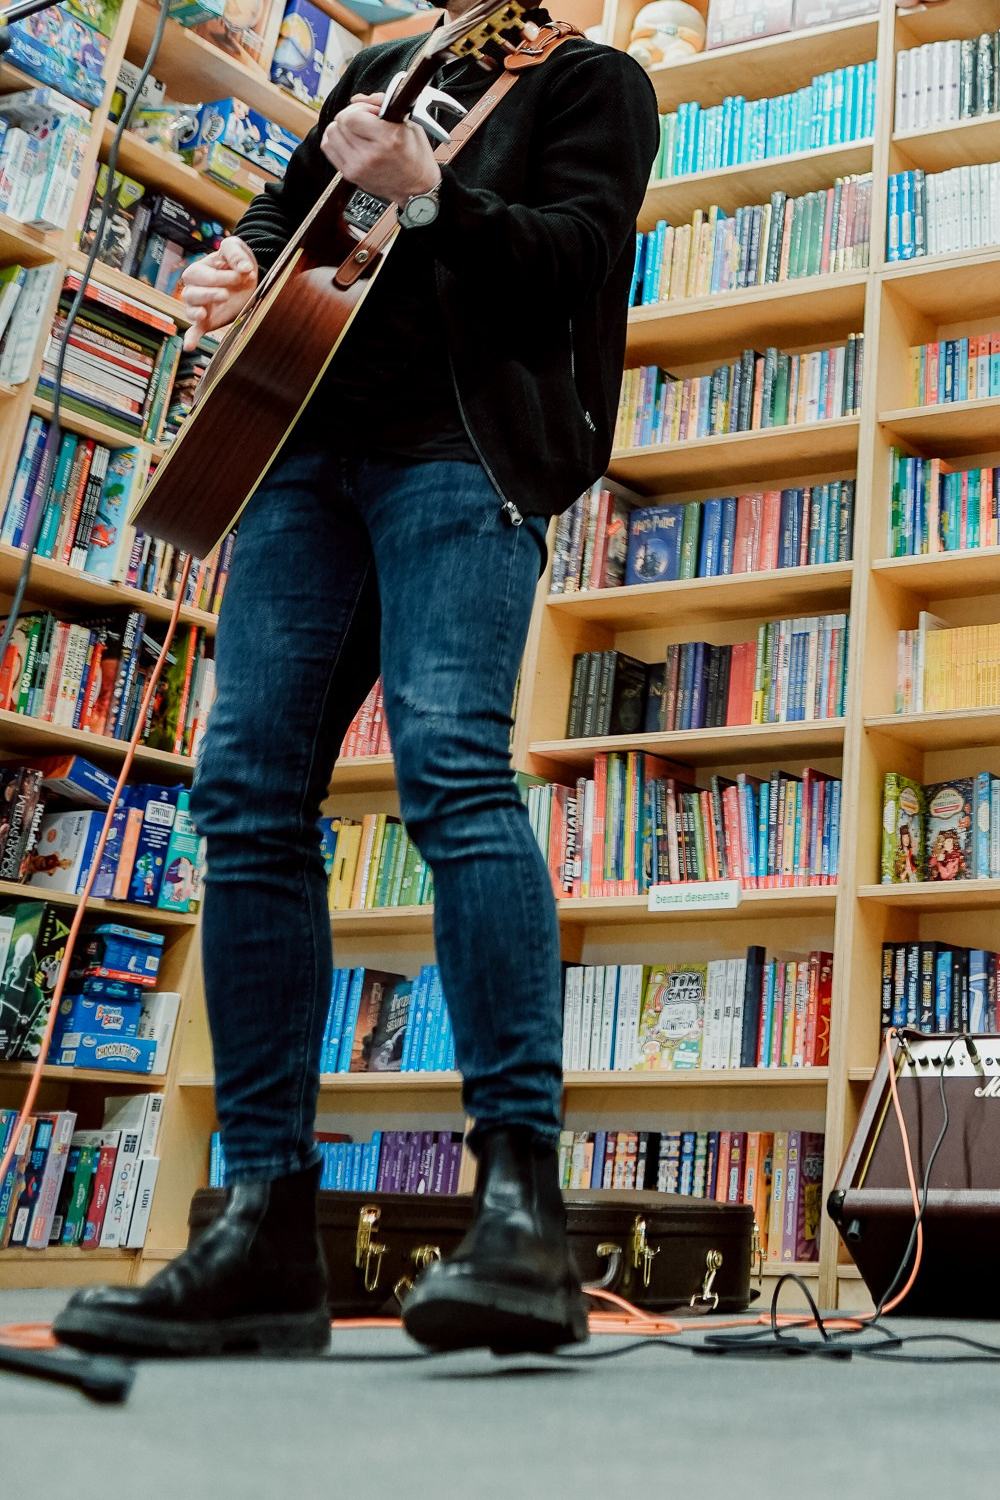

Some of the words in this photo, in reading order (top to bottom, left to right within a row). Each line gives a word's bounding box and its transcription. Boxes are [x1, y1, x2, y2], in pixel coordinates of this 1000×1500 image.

[4, 793, 31, 838] SYSTEM
[769, 780, 778, 825] FANTOMOPOLIS
[561, 795, 578, 893] INVINCIBIL
[666, 987, 702, 1002] GATES
[670, 974, 701, 988] TOM
[112, 1162, 132, 1224] CONTACT
